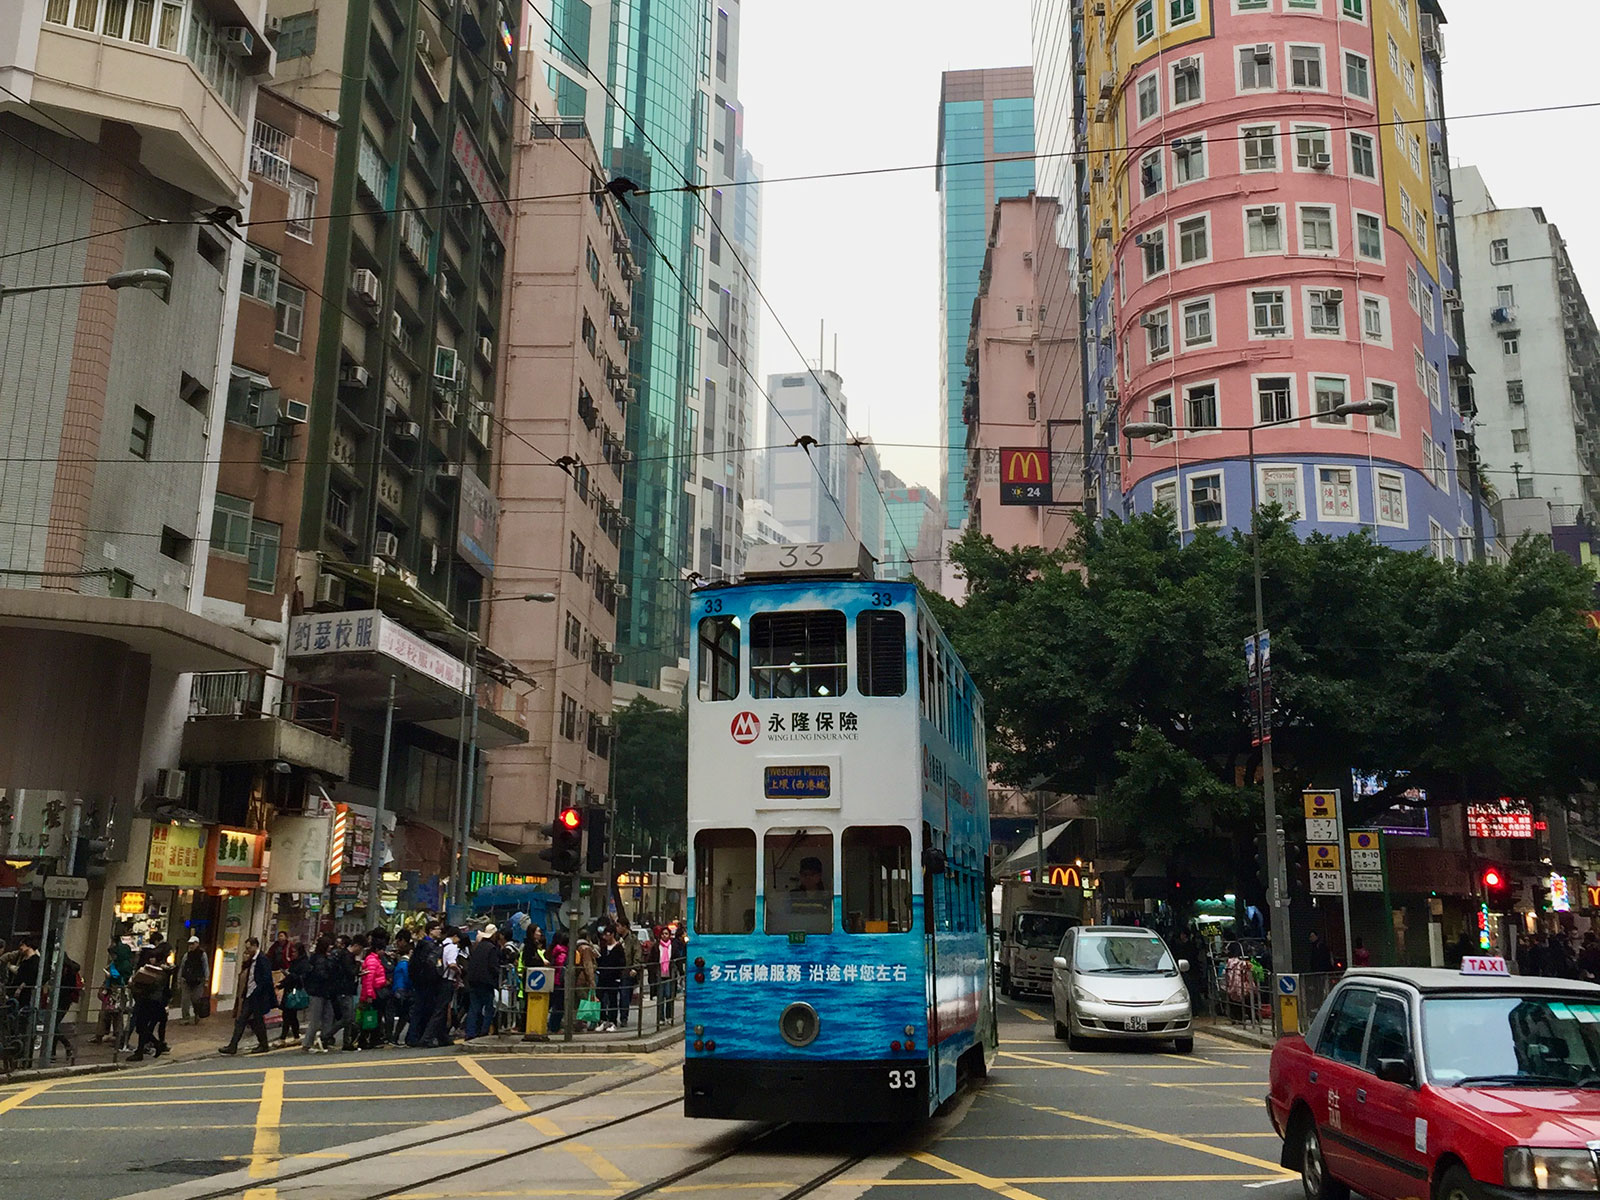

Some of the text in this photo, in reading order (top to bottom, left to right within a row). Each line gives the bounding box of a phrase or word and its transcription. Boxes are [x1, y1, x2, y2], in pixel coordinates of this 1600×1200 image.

[1027, 487, 1041, 497] 24
[778, 544, 824, 568] 33
[704, 598, 723, 613] 33
[871, 592, 892, 607] 33
[768, 711, 858, 732] 永隆保險
[790, 733, 812, 741] LUNG
[813, 733, 859, 741] INSURANCE
[1325, 820, 1331, 828] 7
[1312, 872, 1323, 880] 24
[1315, 881, 1335, 890] 全日
[709, 964, 908, 982] 多元保險服務 沿途伴您左右
[1468, 959, 1504, 973] TAXI
[889, 1070, 916, 1089] 33
